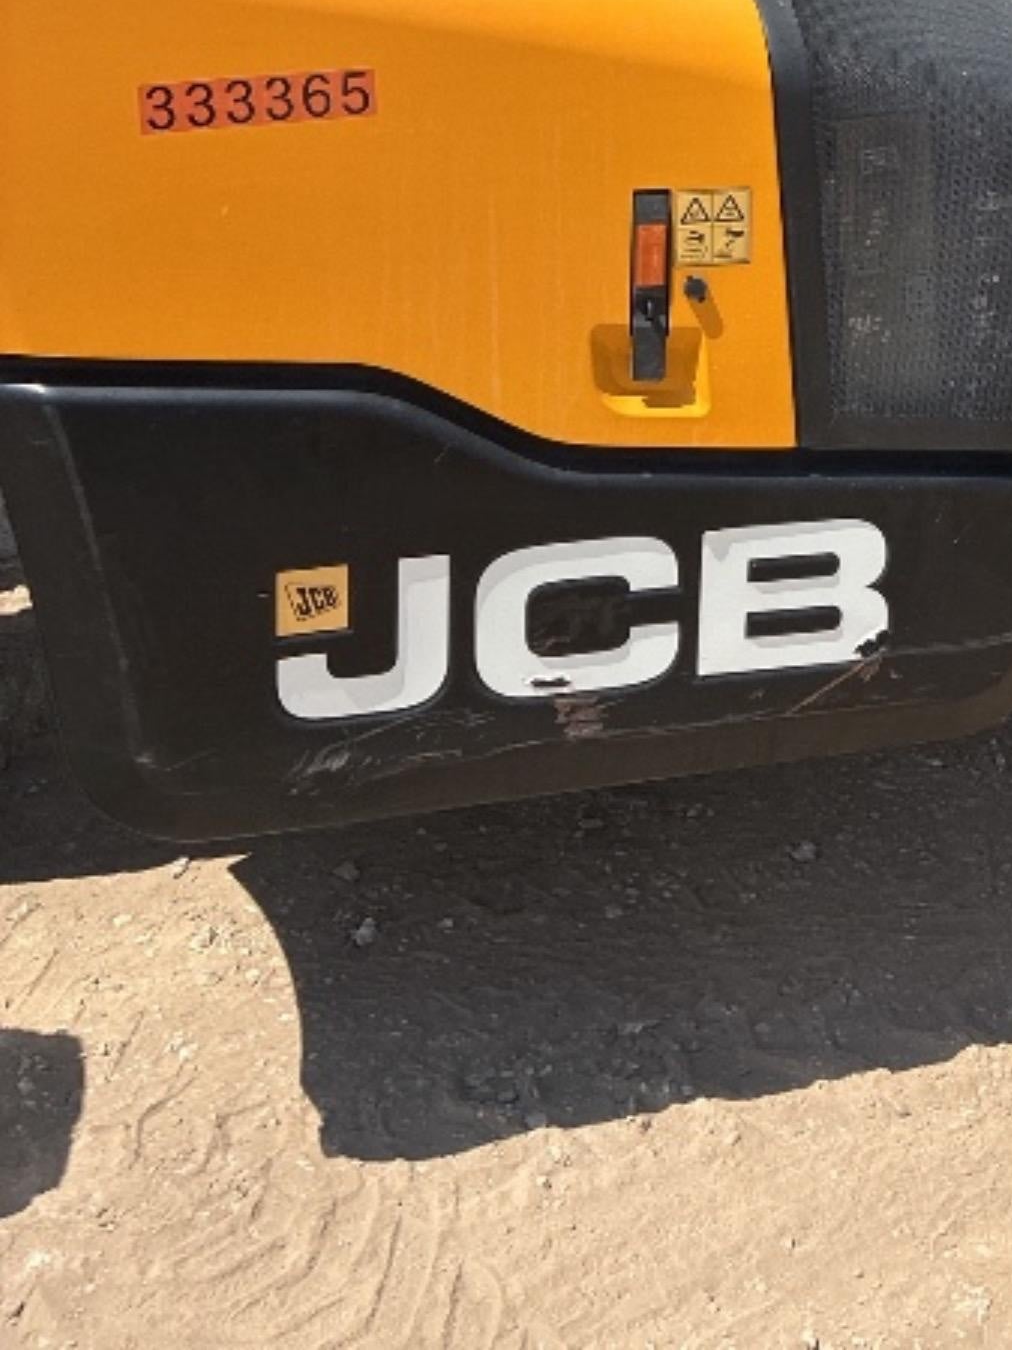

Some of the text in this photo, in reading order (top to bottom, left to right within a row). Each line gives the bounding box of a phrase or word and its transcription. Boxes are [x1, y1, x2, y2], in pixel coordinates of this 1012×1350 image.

[145, 70, 370, 131] 333365
[276, 518, 889, 720] JCB
[295, 585, 338, 617] JCB
